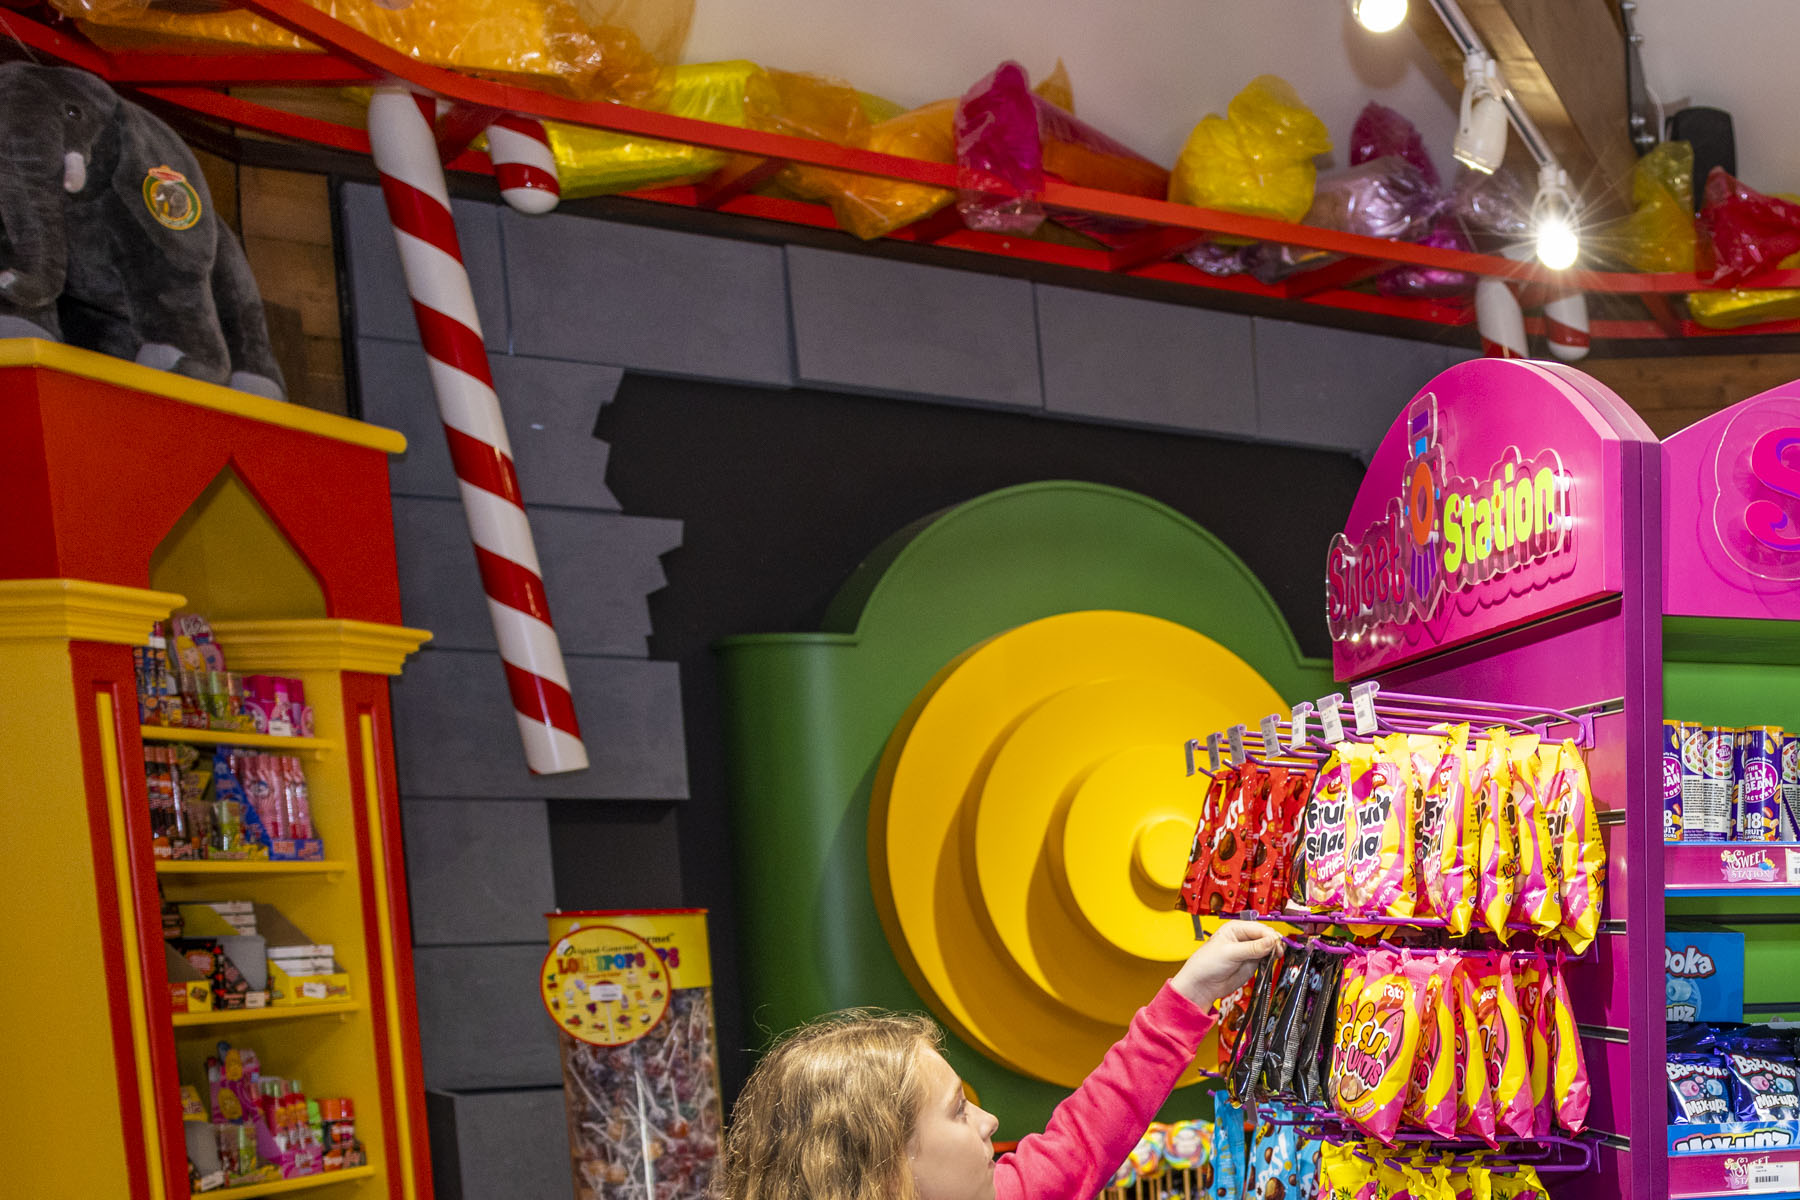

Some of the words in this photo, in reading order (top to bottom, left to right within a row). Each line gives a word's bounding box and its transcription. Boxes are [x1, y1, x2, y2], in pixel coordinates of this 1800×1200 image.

[1329, 513, 1406, 622] Sweet
[1443, 461, 1555, 574] Station
[1307, 797, 1345, 830] Frui
[1746, 812, 1762, 828] 18
[1735, 1053, 1796, 1079] Bazooka
